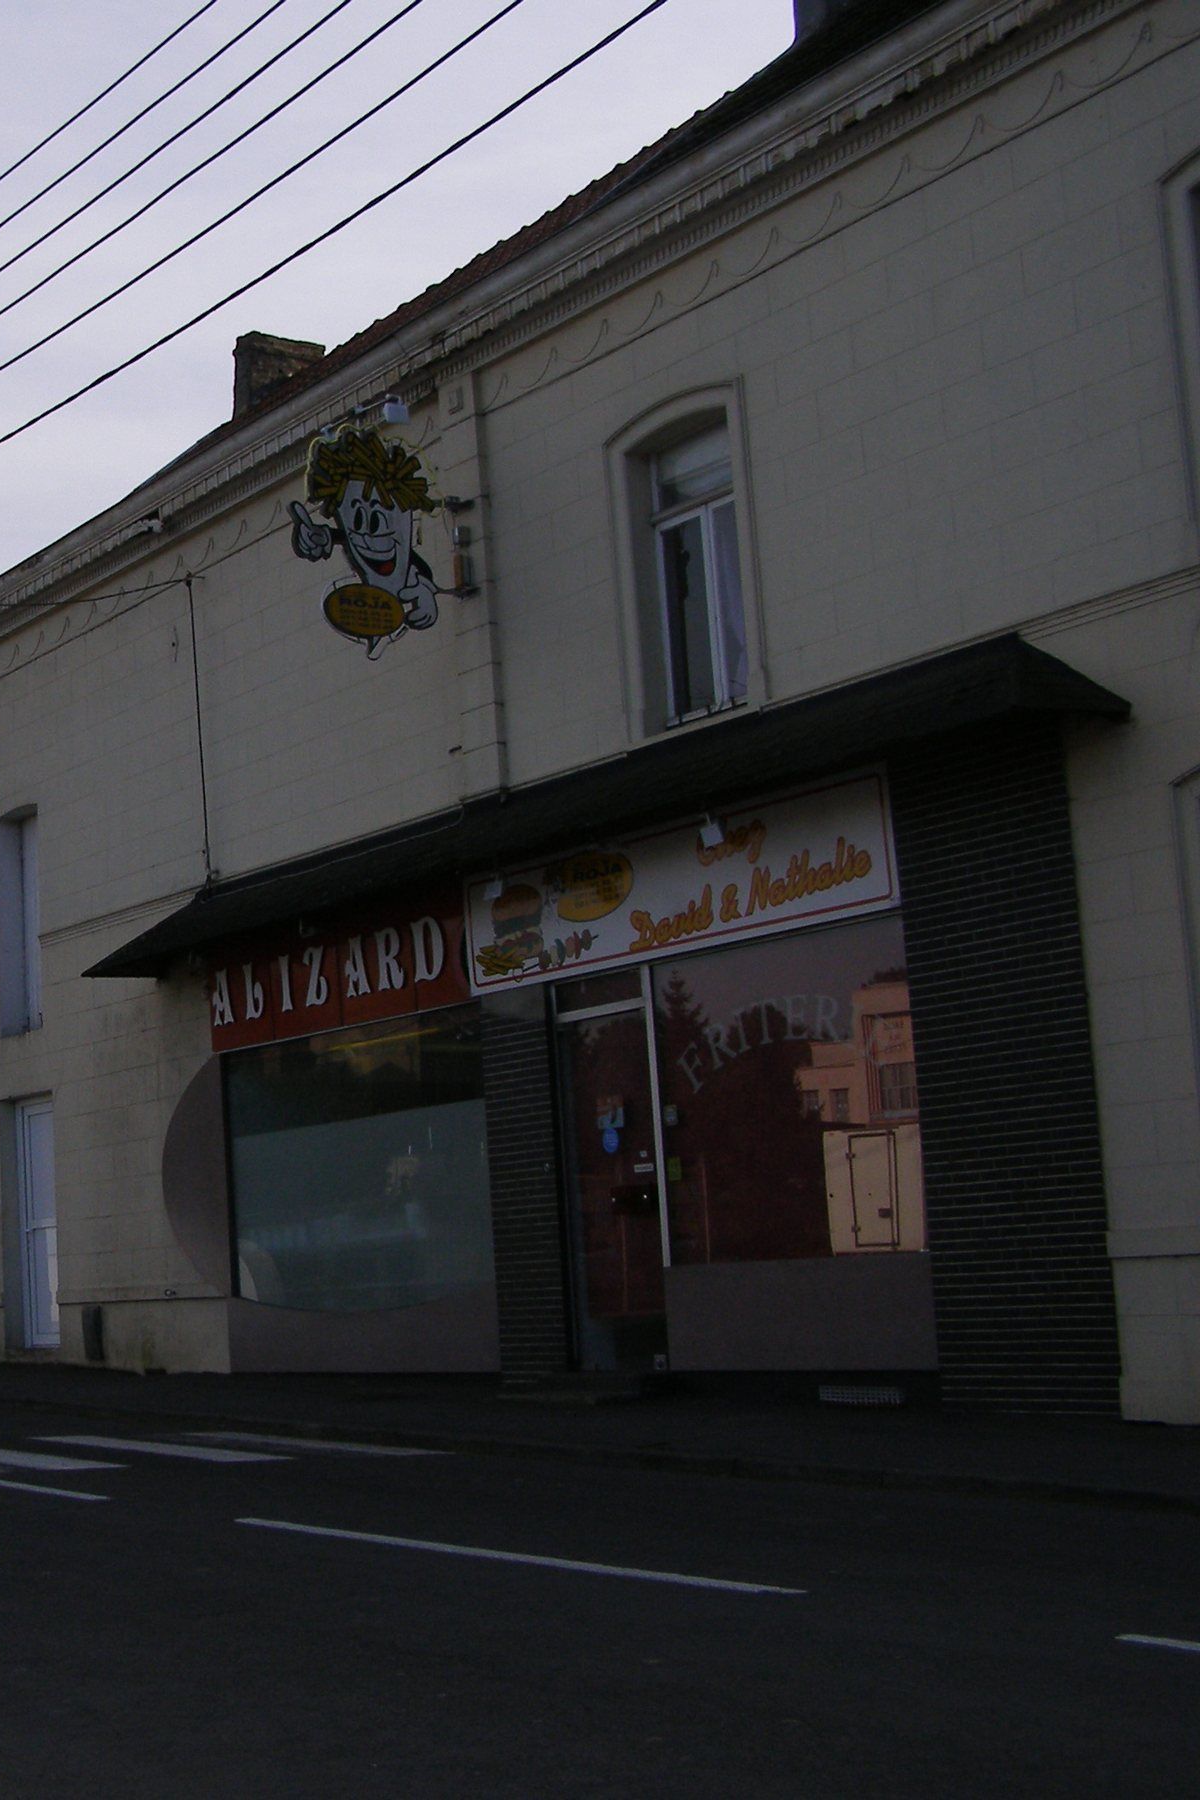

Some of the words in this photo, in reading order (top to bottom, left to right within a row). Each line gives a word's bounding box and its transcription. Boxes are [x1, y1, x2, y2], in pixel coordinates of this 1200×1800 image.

[629, 883, 714, 952] David
[719, 882, 743, 923] &
[744, 835, 872, 917] Nathalie
